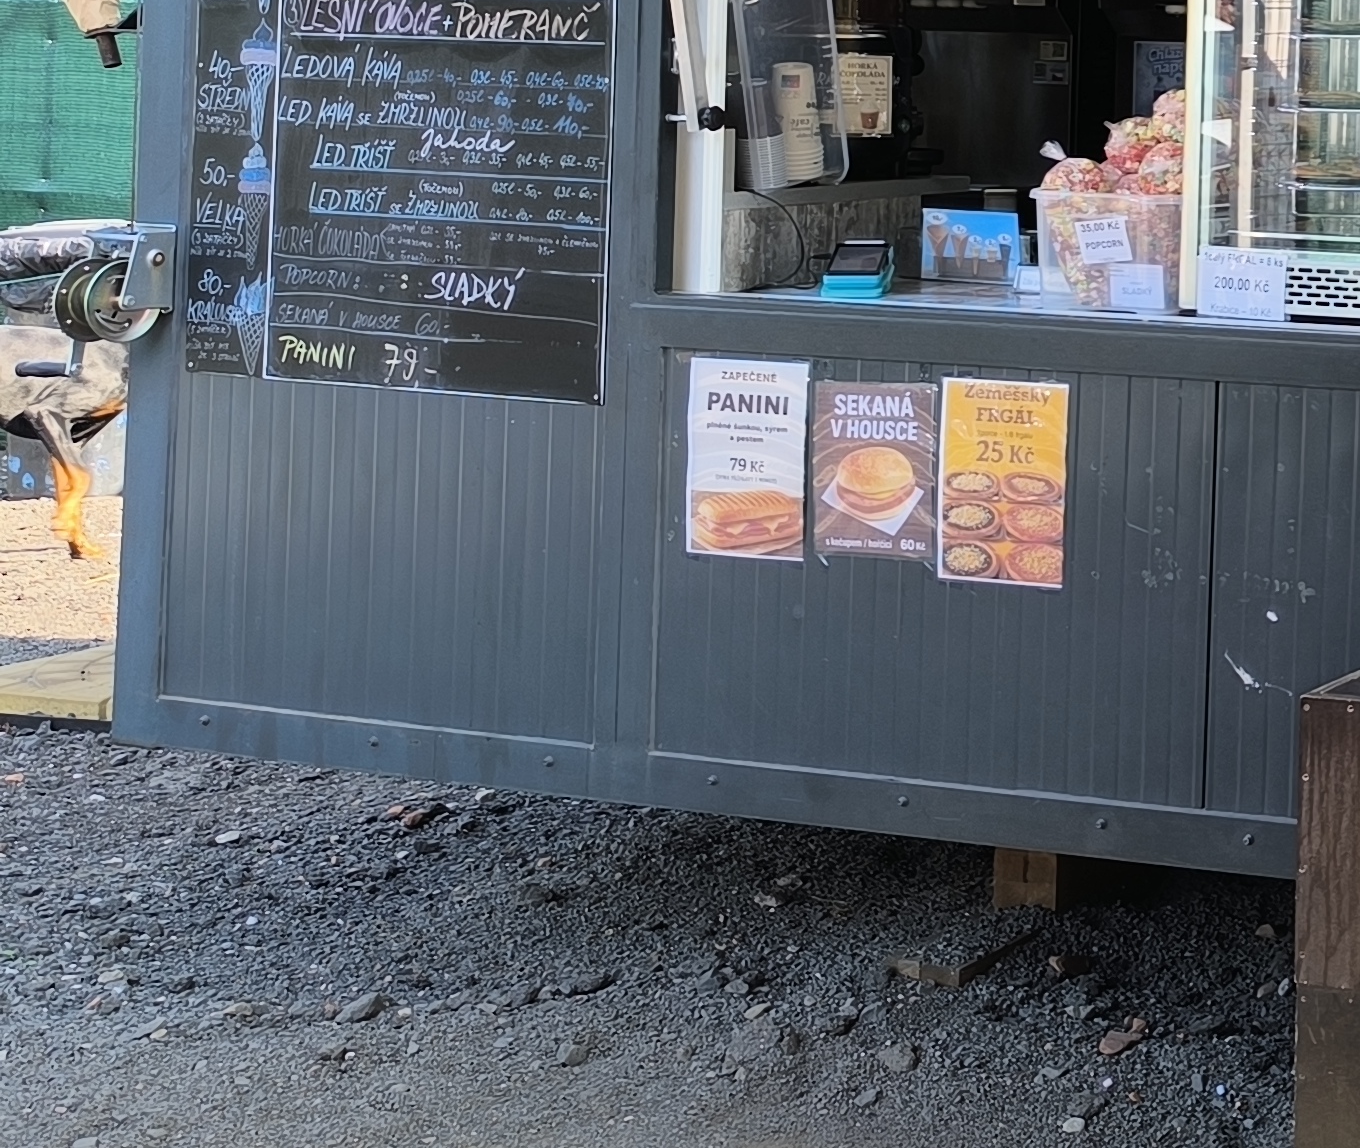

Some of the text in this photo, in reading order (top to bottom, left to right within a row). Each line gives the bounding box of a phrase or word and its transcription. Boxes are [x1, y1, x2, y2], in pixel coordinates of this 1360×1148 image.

[376, 0, 443, 35] OVOCE
[209, 50, 244, 79] 40,-
[281, 45, 402, 89] LEDOVÁ KÁVA
[848, 62, 878, 70] HORKÁ
[421, 129, 515, 157] Jahoda
[200, 158, 235, 186] 50,-
[1080, 222, 1120, 233] 35,00 Kč
[1086, 240, 1124, 250] POPCORN
[1274, 260, 1283, 268] ks
[198, 268, 232, 295] 80,-
[424, 268, 526, 309] SLADKÝ
[1215, 276, 1269, 293] 200,00 Kč
[277, 302, 333, 326] SEKANÁ
[356, 314, 402, 330] HOUSCE
[279, 335, 356, 370] PANINI
[721, 371, 777, 383] ZAPEČENÉ
[707, 392, 789, 416] PANINI
[834, 392, 914, 417] SEKANÁ
[976, 406, 1042, 424] FRGÁL
[831, 419, 918, 440] V HOUSCE
[976, 440, 1034, 464] 25 Kč
[730, 458, 765, 473] 79 Kč
[901, 539, 914, 550] 60
